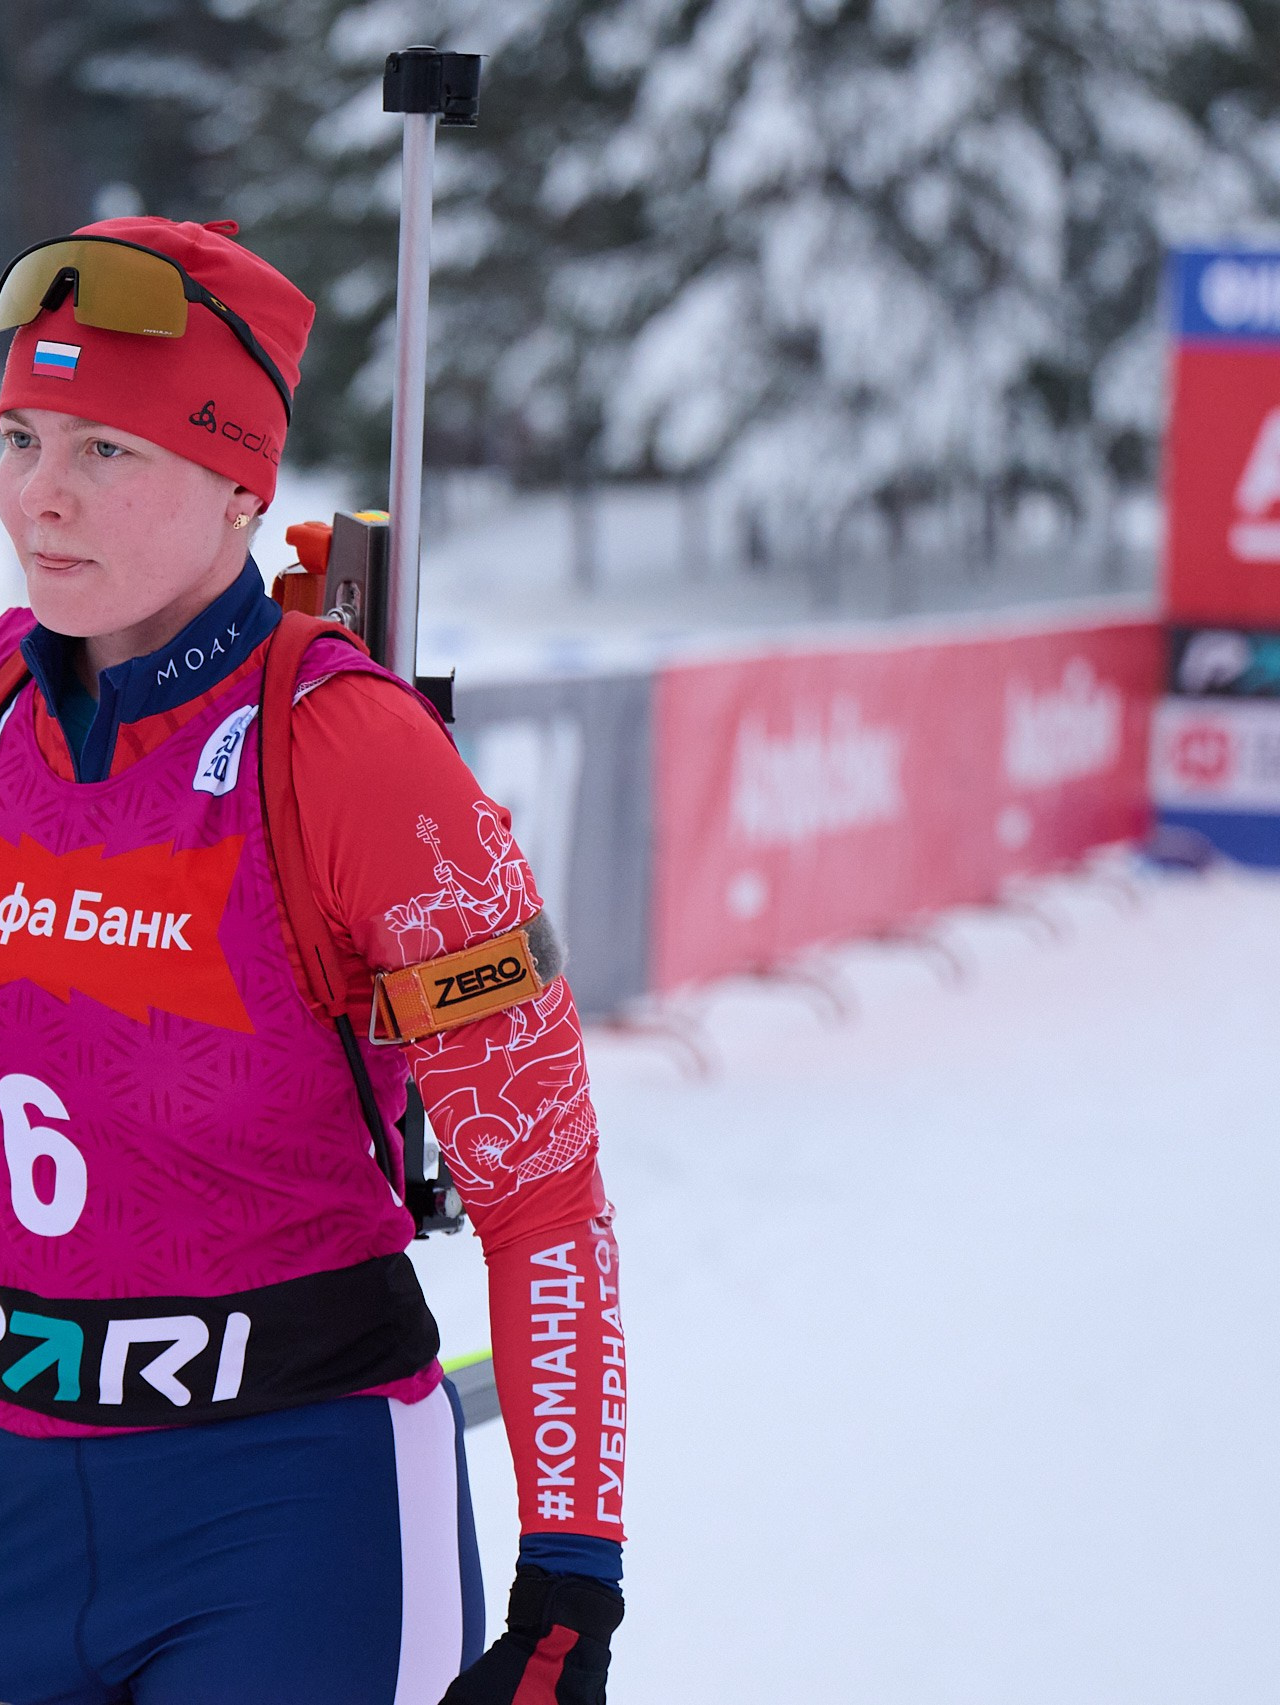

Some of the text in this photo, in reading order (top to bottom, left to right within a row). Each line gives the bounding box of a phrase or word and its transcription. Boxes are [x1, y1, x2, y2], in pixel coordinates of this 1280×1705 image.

[157, 623, 241, 685] MOAX
[64, 889, 193, 951] Банк
[434, 955, 528, 1010] ZERO
[530, 1240, 585, 1521] #КОМАНДА
